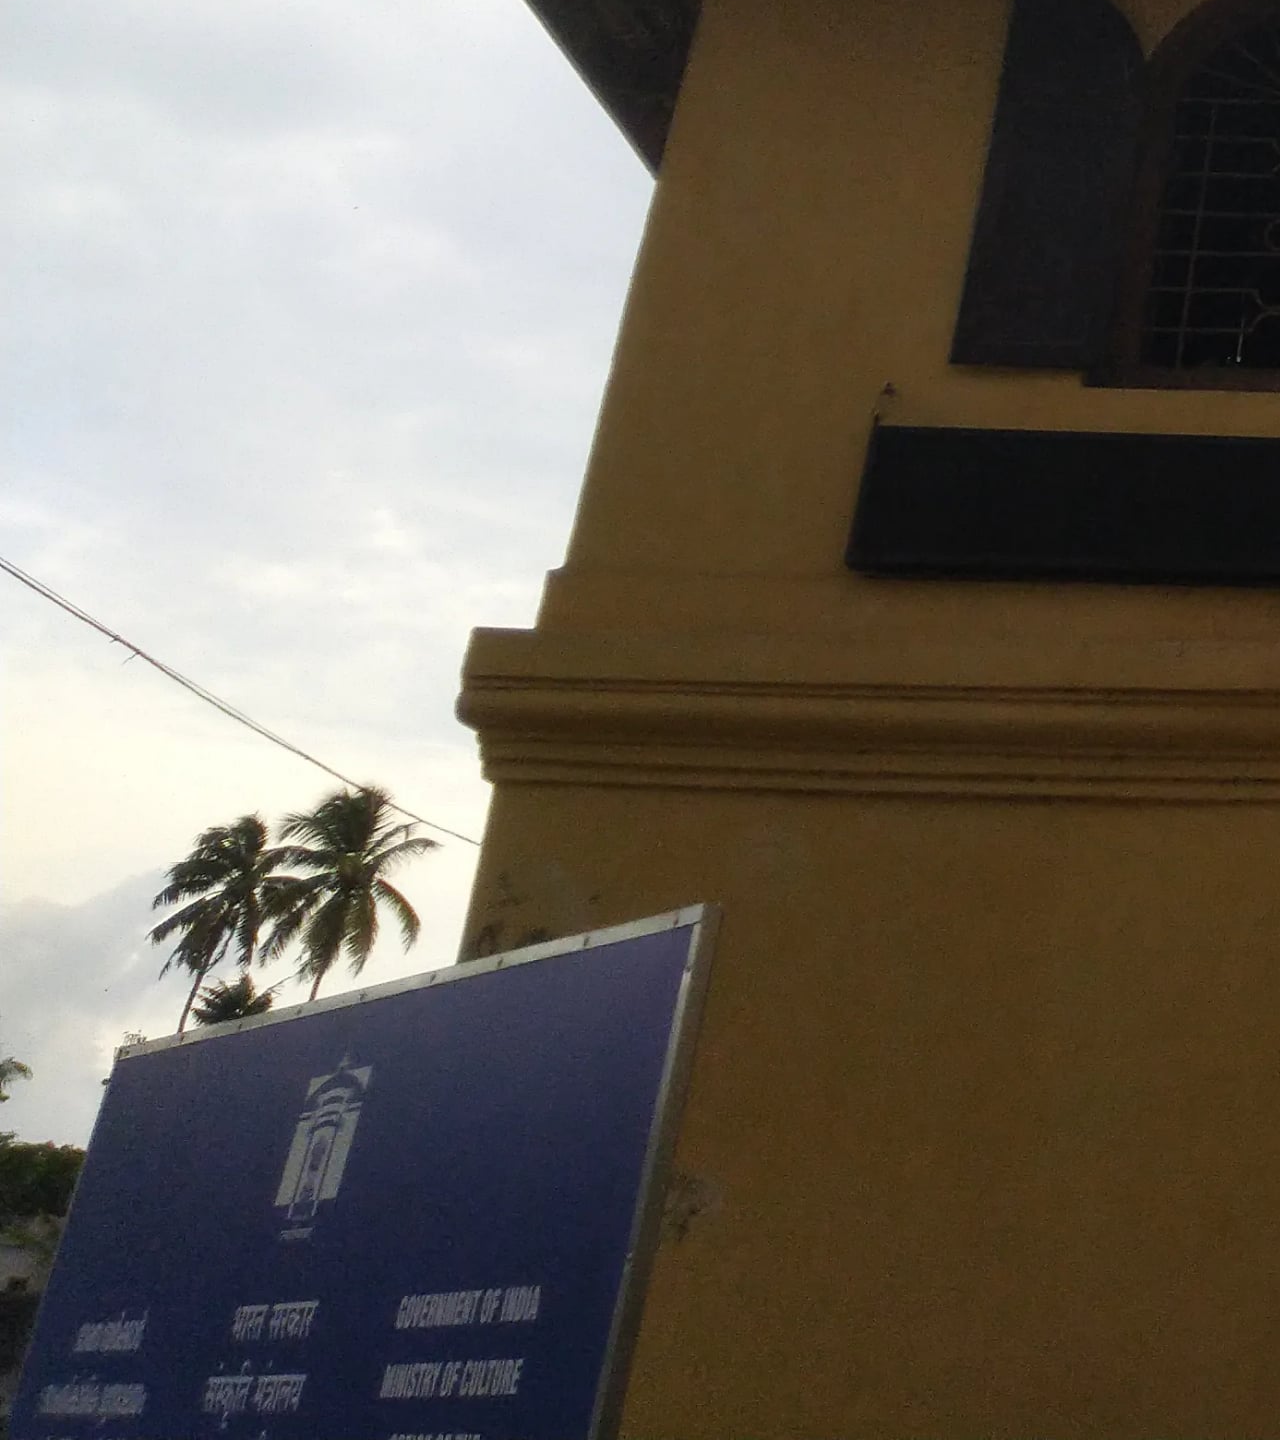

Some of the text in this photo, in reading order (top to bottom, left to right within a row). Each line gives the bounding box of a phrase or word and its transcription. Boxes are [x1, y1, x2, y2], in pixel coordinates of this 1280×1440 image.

[231, 1300, 320, 1342] भारत सरकार
[395, 1285, 542, 1329] GOVERNMENT OF INDIA
[379, 1358, 525, 1399] MINISTRY OF CULTURE
